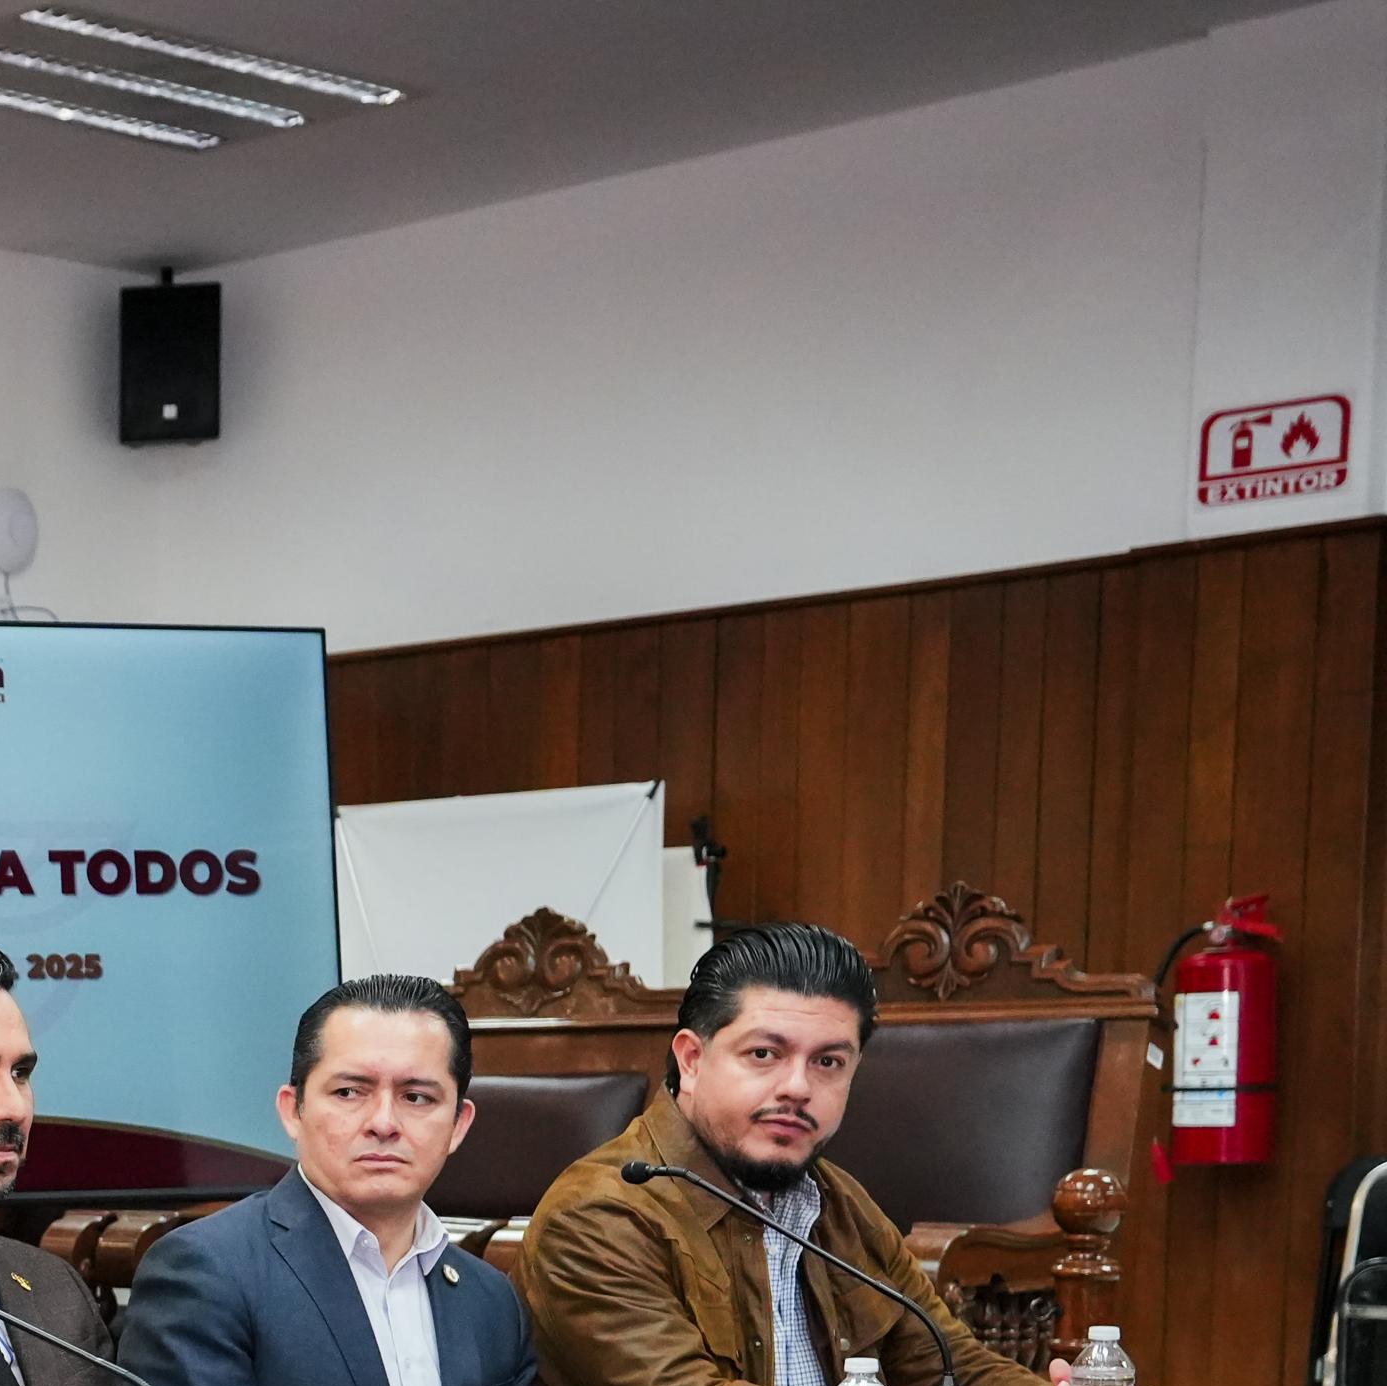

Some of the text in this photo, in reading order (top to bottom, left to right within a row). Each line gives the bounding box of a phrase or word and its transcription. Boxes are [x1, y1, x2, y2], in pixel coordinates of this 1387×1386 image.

[1207, 471, 1337, 505] EXTINTOR
[47, 848, 261, 898] TODOS
[27, 954, 103, 980] 2025
